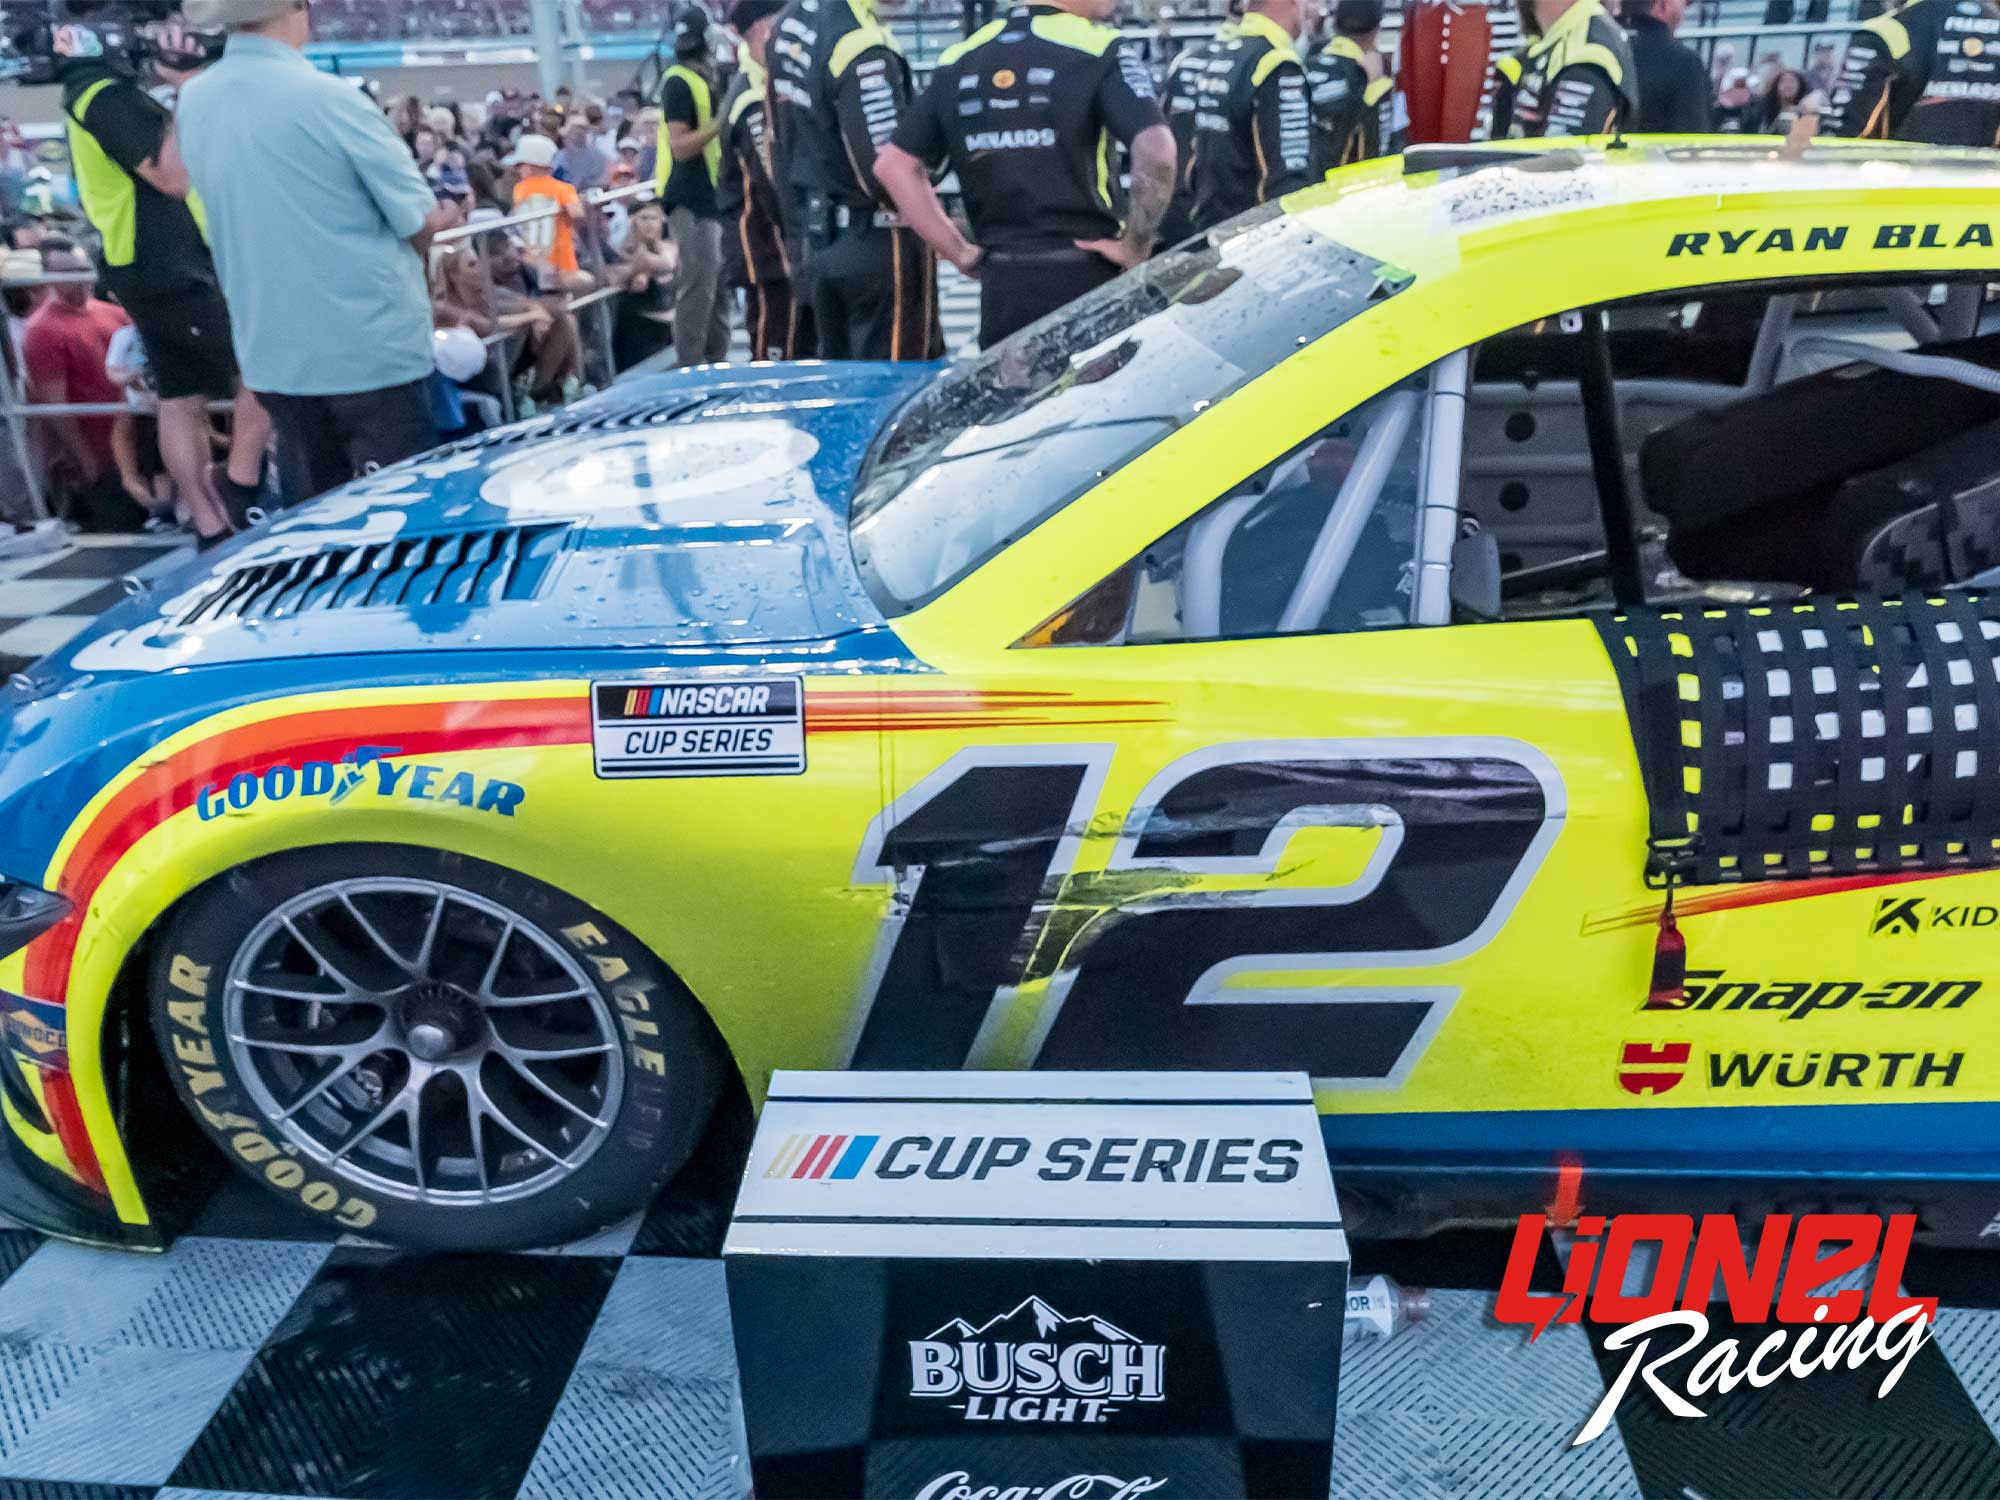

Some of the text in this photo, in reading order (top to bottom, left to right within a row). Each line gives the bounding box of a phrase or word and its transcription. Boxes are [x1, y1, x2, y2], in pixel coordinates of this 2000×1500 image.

[1665, 223, 1994, 257] RYAN BLA
[658, 685, 771, 716] NASCAR
[624, 726, 774, 755] CUP SERIES
[848, 735, 1568, 1090] 12
[1931, 906, 2000, 927] KID
[559, 919, 667, 1079] EAGLE
[874, 1135, 1304, 1184] CUP SERIES
[908, 1340, 1167, 1402] BUSCH
[963, 1397, 1108, 1423] LIGHT
